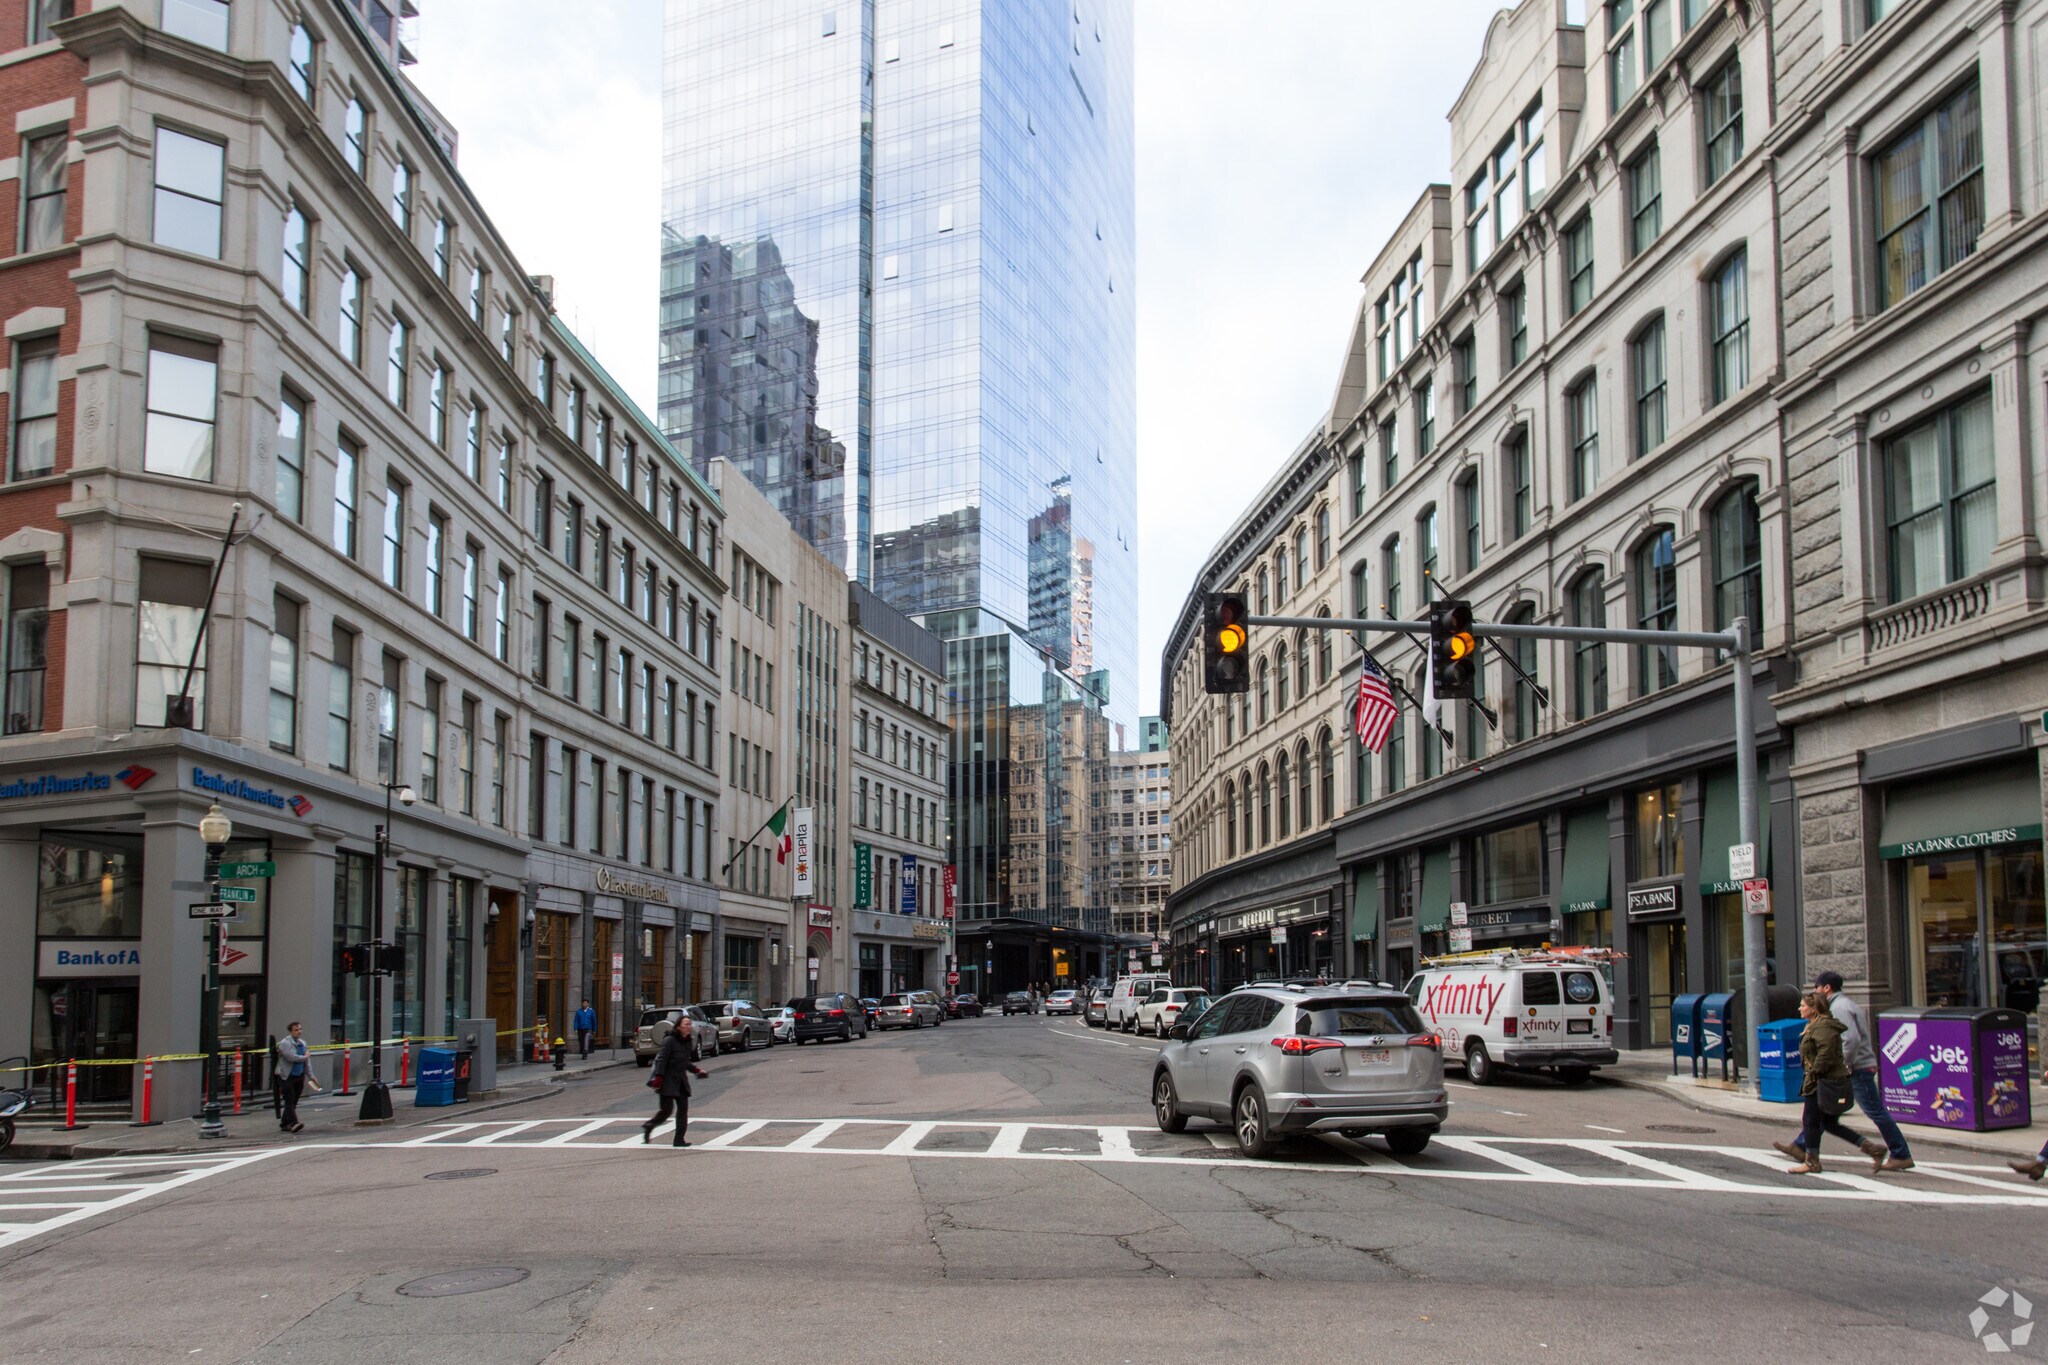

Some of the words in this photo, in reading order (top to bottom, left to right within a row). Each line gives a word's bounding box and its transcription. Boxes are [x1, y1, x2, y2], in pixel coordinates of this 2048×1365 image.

[0, 779, 27, 798] ank
[30, 776, 46, 794] of
[46, 772, 111, 793] America
[193, 767, 226, 794] Bank
[226, 779, 240, 797] of
[239, 781, 285, 809] America
[1956, 828, 2017, 848] CLOTHIERS
[1731, 846, 1752, 857] YIELD
[236, 865, 258, 876] ARCH
[220, 888, 249, 901] FRANKLIN
[193, 907, 206, 915] ONE
[210, 905, 223, 913] WAY
[1469, 911, 1512, 926] STREET
[1423, 923, 1443, 932] PAPYRUS
[57, 950, 105, 965] Bank
[107, 950, 126, 965] of
[1423, 974, 1506, 1025] xfinity
[1522, 1019, 1560, 1033] xfinity
[1997, 1032, 2022, 1047] jet
[1929, 1044, 1968, 1065] jet
[1946, 1064, 1968, 1073] .com
